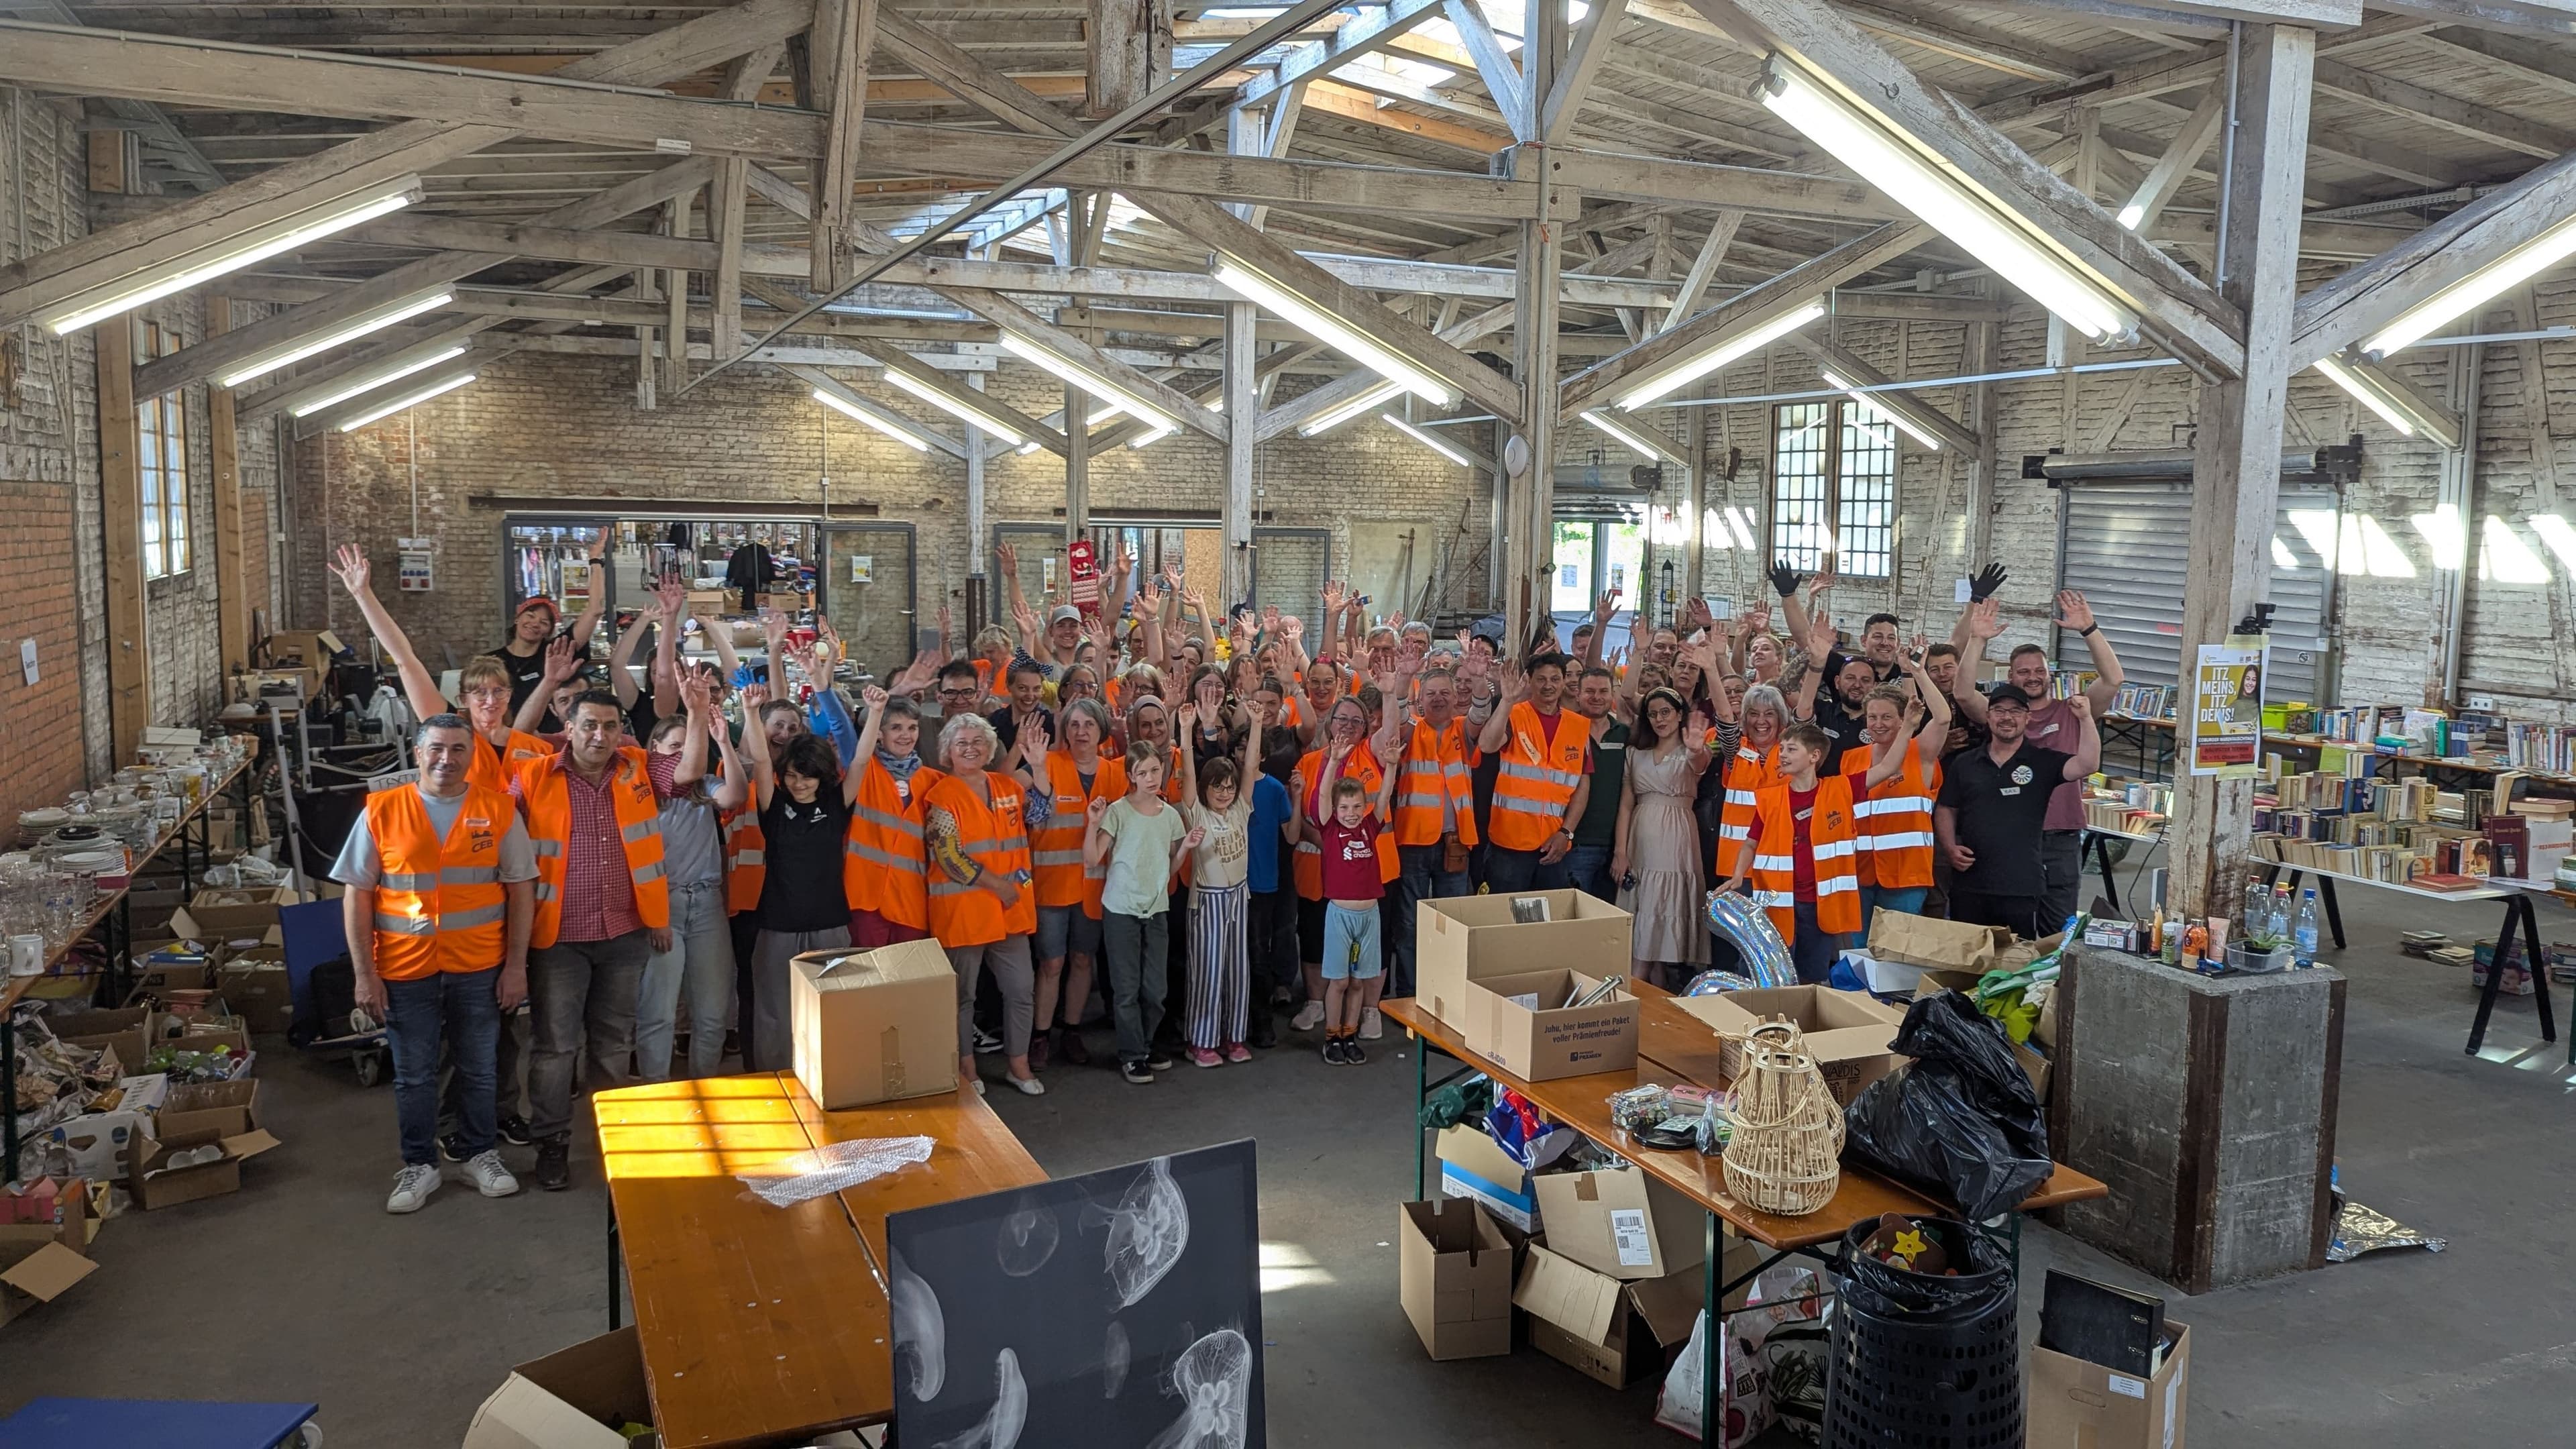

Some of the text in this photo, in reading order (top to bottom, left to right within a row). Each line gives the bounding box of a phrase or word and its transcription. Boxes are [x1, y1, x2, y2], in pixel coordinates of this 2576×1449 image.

[2212, 667, 2229, 680] ITZ
[2201, 681, 2237, 695] MEINS,
[2210, 695, 2228, 708] ITZ
[1565, 753, 1579, 762] CEB
[1362, 773, 1375, 785] CEB
[1888, 775, 1905, 788] CEB
[637, 788, 652, 804] CEB
[1828, 816, 1842, 830] CEB
[472, 839, 494, 853] CEB
[1544, 1016, 1630, 1033] Juhu, hier kommt ein Paket
[1553, 1027, 1621, 1043] voller Prämienfreude!
